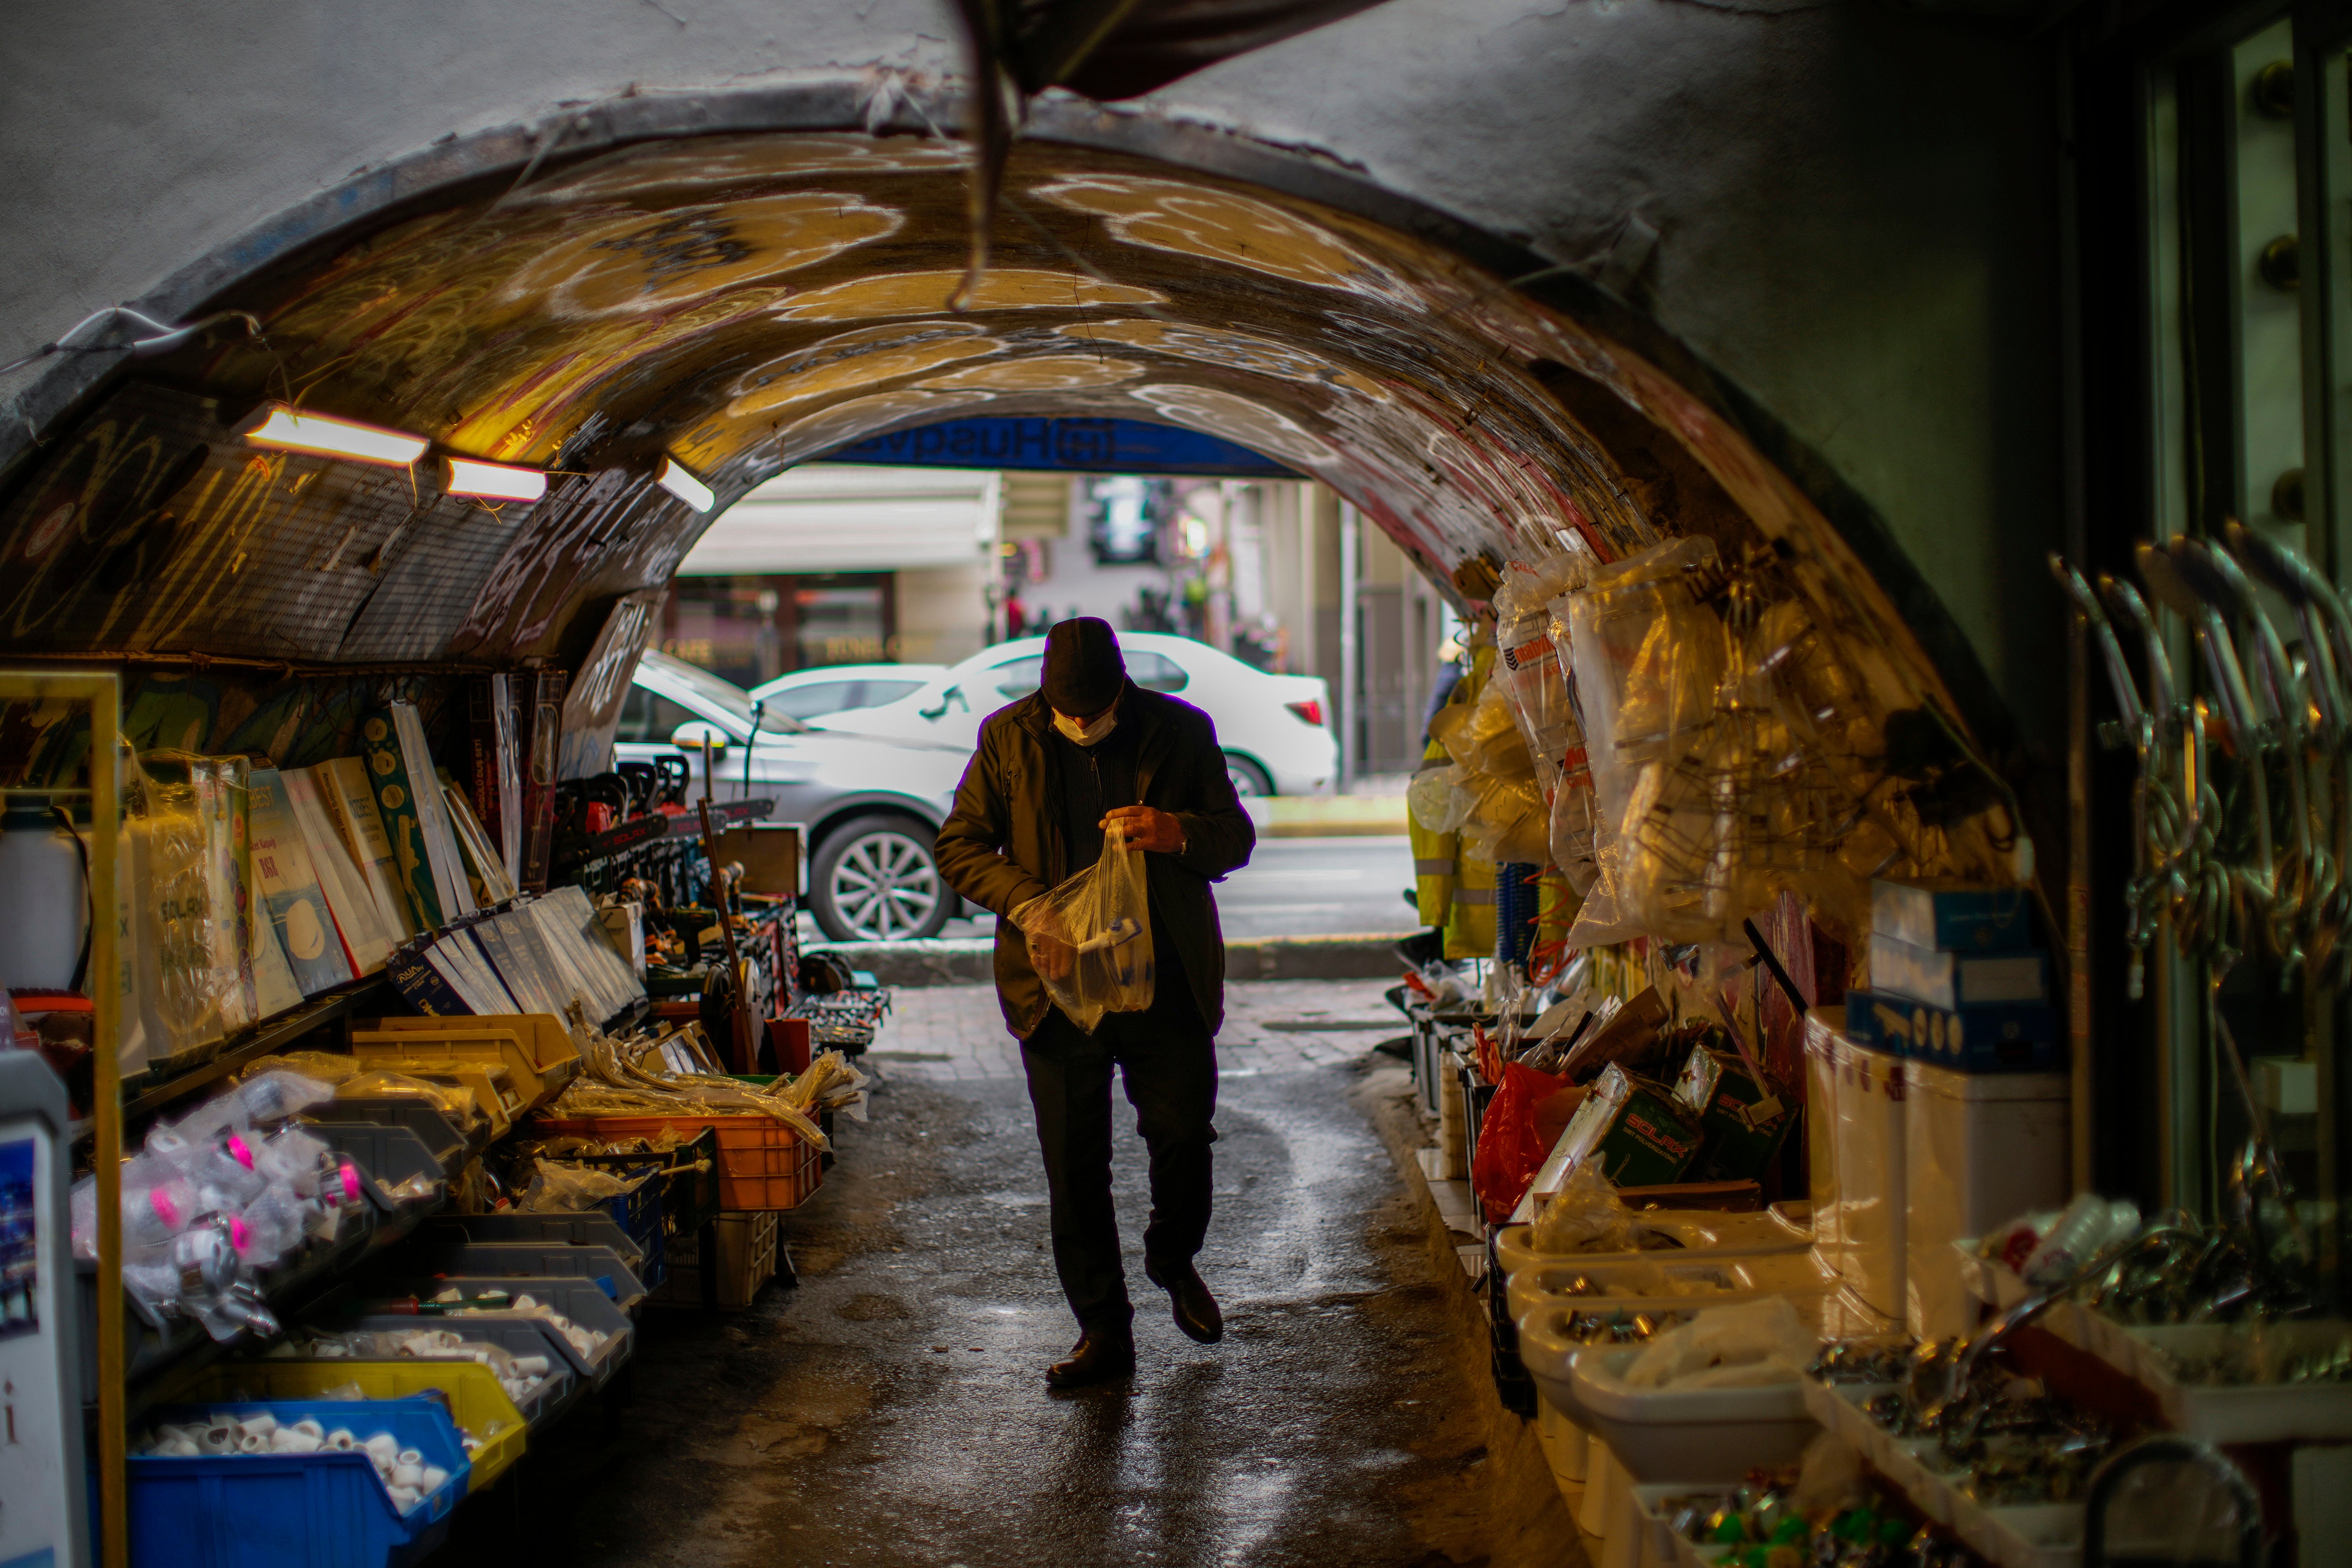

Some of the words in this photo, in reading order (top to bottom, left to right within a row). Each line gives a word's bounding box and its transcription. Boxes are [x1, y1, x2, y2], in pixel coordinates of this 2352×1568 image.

[248, 786, 275, 810] BEST
[613, 827, 647, 846] SOLAX
[1623, 1126, 1636, 1136] SIRT
[1625, 1113, 1688, 1158] SOLAX
